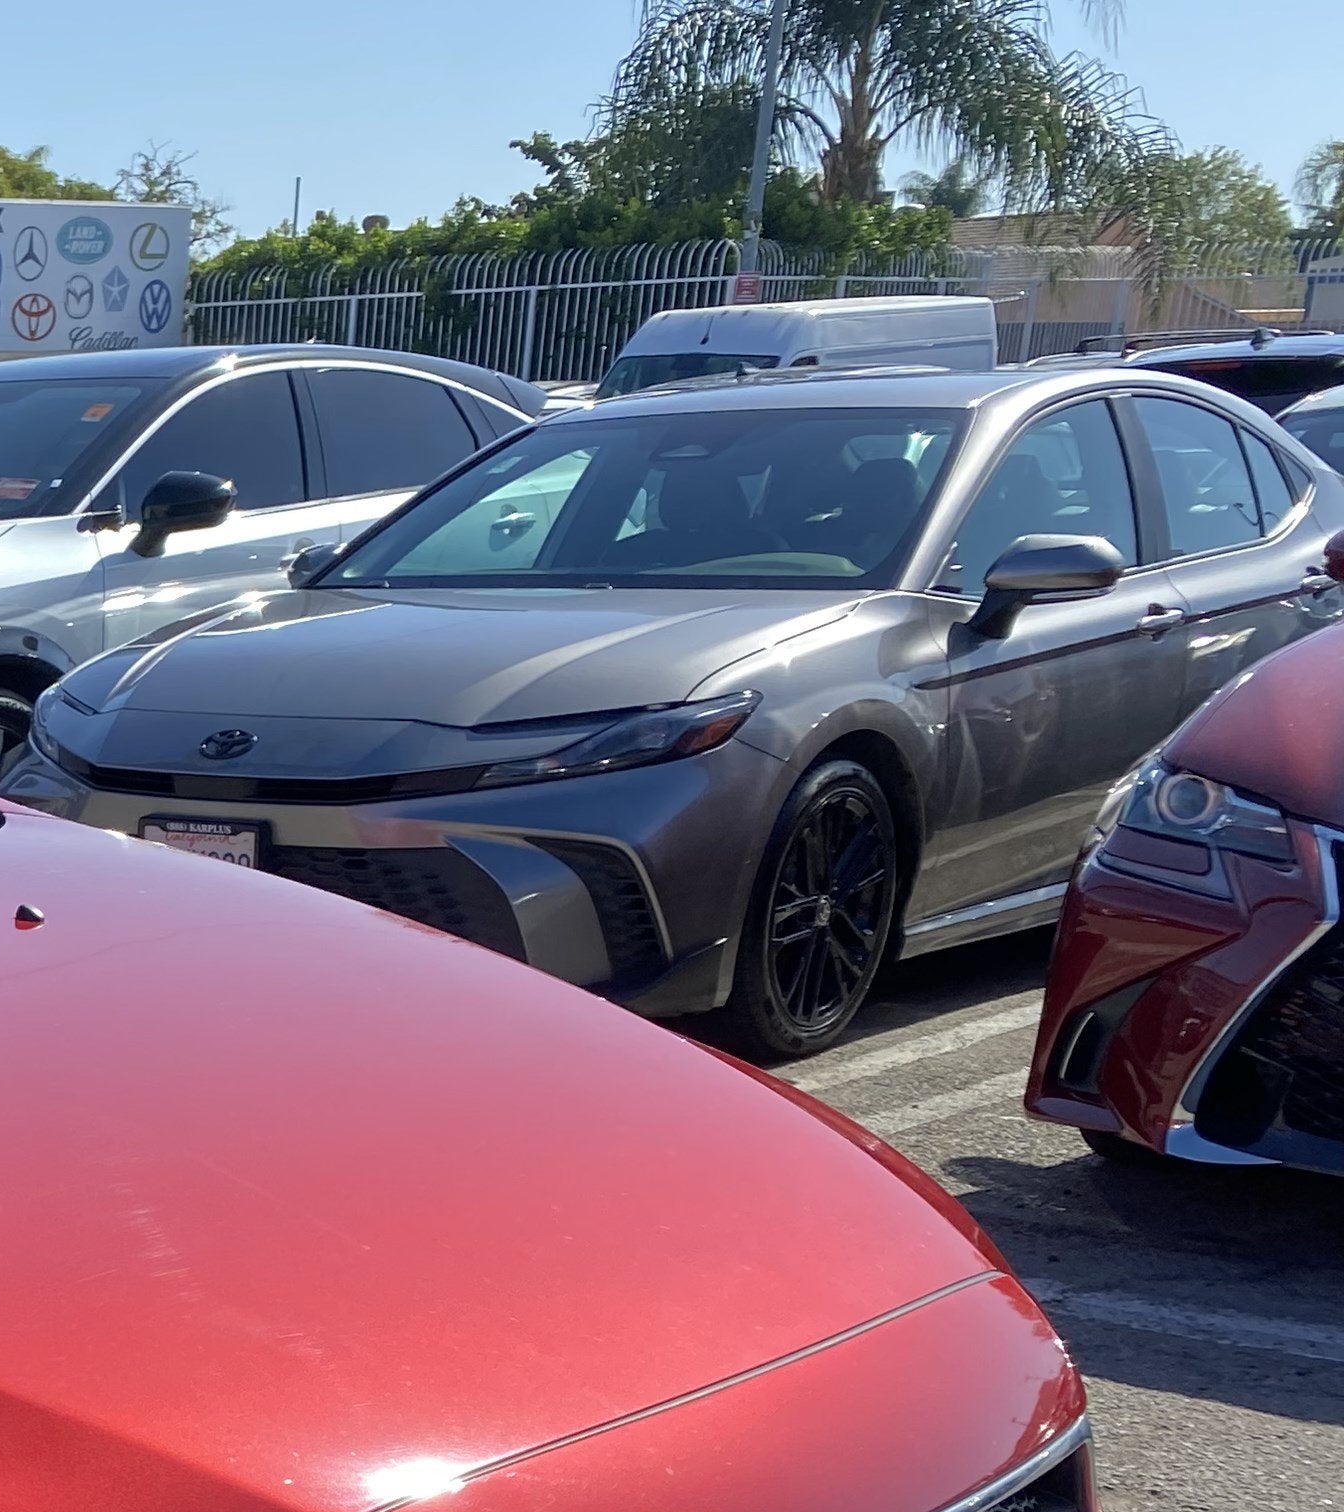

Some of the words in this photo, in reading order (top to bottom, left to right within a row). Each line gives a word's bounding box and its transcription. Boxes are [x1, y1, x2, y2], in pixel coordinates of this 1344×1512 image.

[68, 225, 98, 239] LAND
[69, 239, 105, 254] ROVER
[68, 325, 139, 350] Cadillac
[189, 823, 232, 834] KARPLUS
